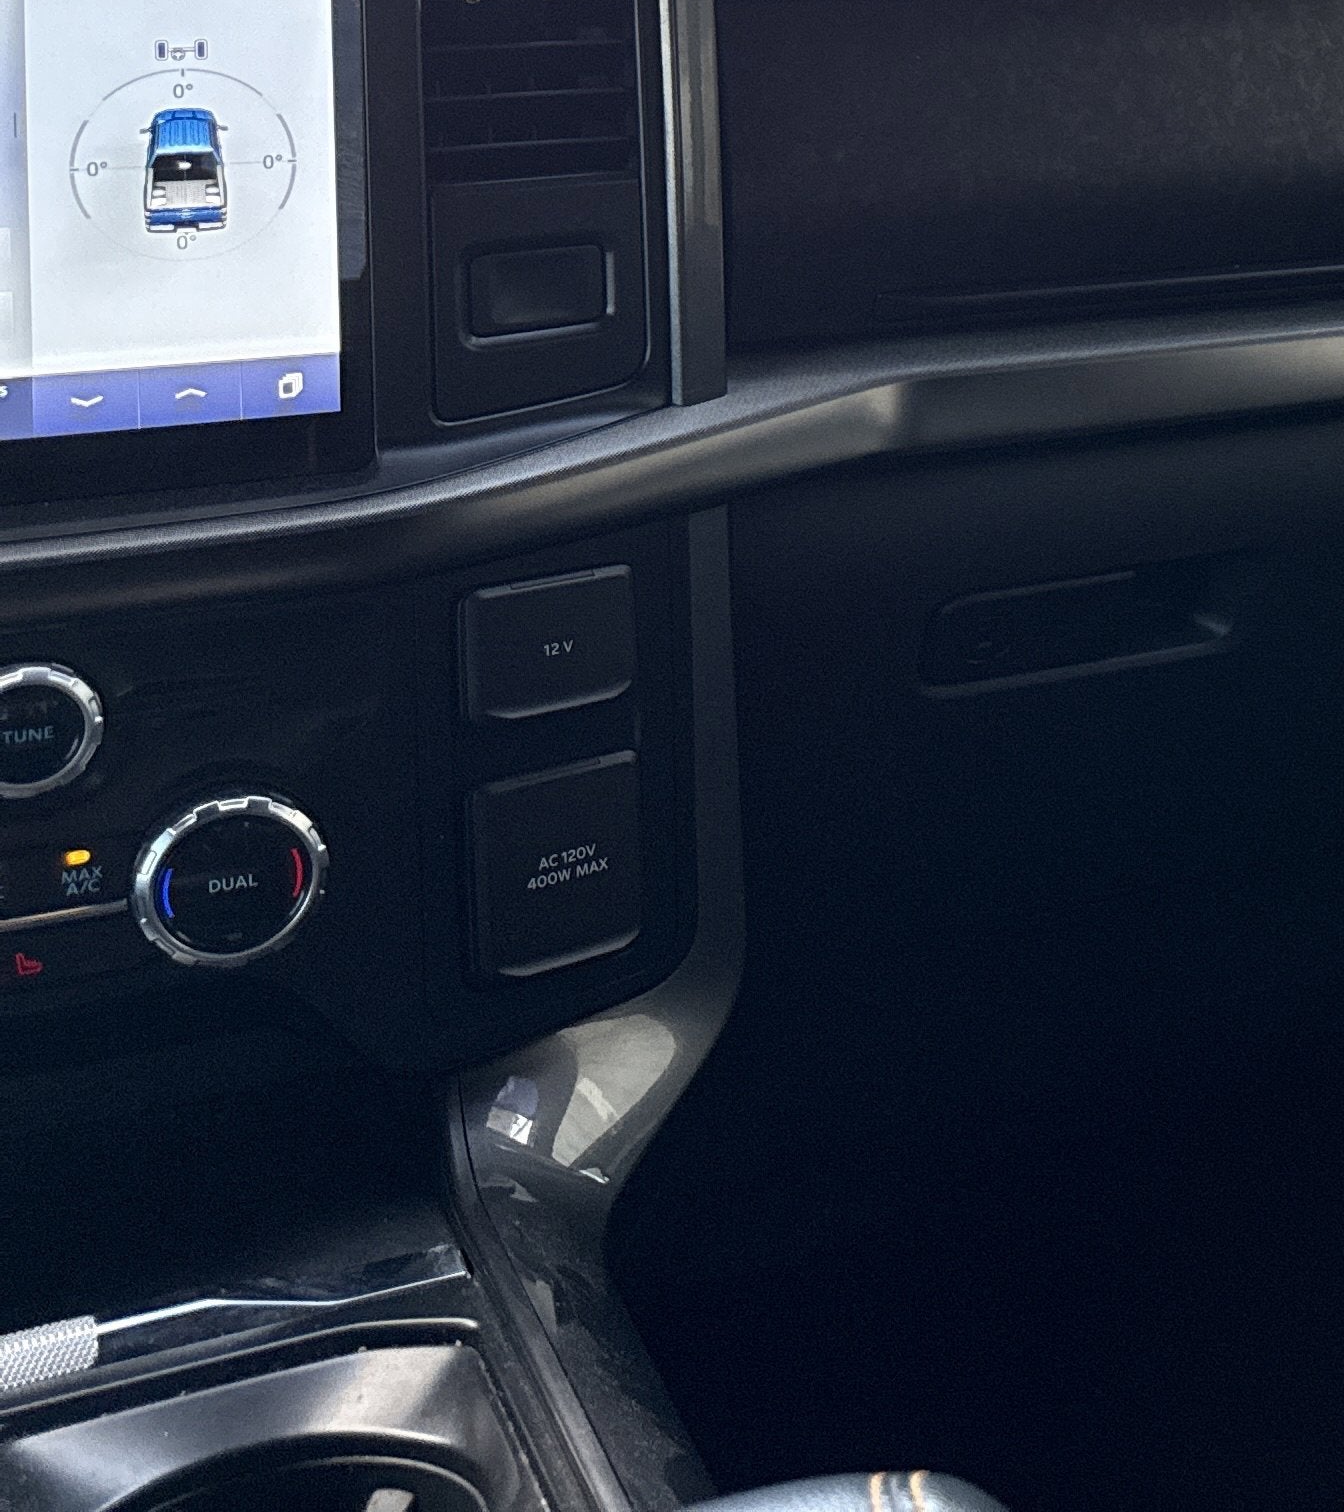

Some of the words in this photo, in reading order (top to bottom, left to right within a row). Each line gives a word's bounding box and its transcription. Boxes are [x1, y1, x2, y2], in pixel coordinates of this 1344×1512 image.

[172, 84, 194, 98] 0°
[86, 162, 108, 177] 0°
[262, 154, 283, 170] 0°
[176, 235, 197, 250] 0°
[543, 641, 560, 657] 12
[562, 639, 574, 654] V
[3, 725, 54, 744] TUNE
[538, 853, 560, 872] AC
[560, 843, 597, 865] 120V
[61, 864, 103, 886] MAX
[526, 867, 572, 890] 400W
[575, 856, 609, 878] MAX
[66, 876, 102, 897] A/C
[208, 872, 259, 894] DUAL
